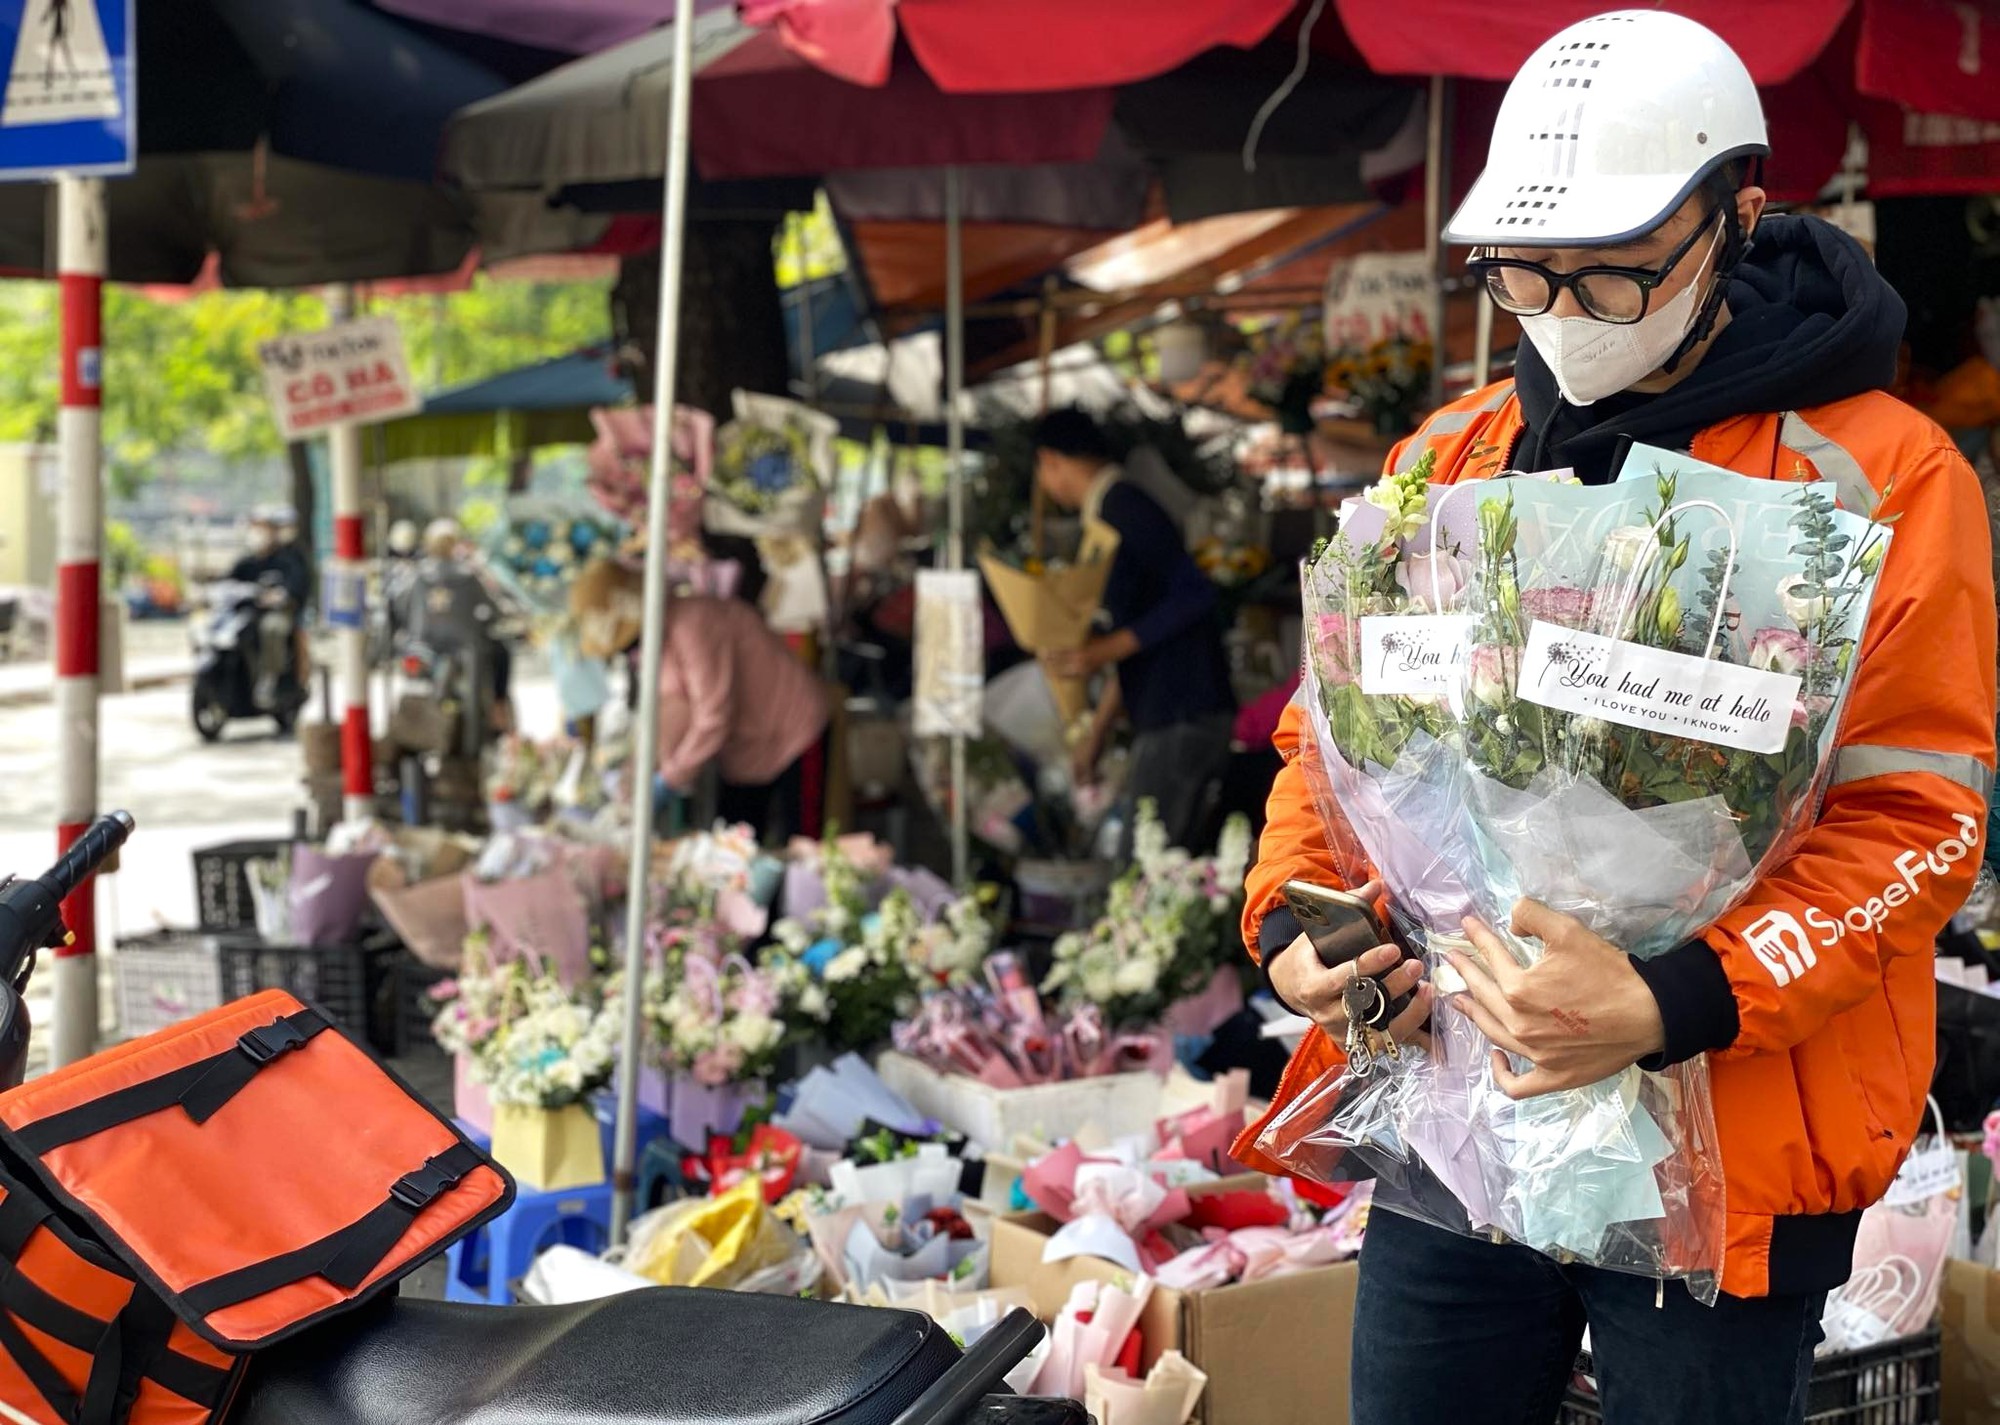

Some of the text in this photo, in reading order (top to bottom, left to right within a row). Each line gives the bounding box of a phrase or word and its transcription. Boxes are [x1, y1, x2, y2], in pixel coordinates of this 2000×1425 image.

[1399, 644, 1441, 672] You
[1559, 658, 1772, 723] You had me at hello
[1601, 700, 1637, 715] LOVE
[1641, 707, 1668, 721] YOU
[1691, 718, 1731, 733] KNOW
[1805, 812, 1978, 947] SoeeFood
